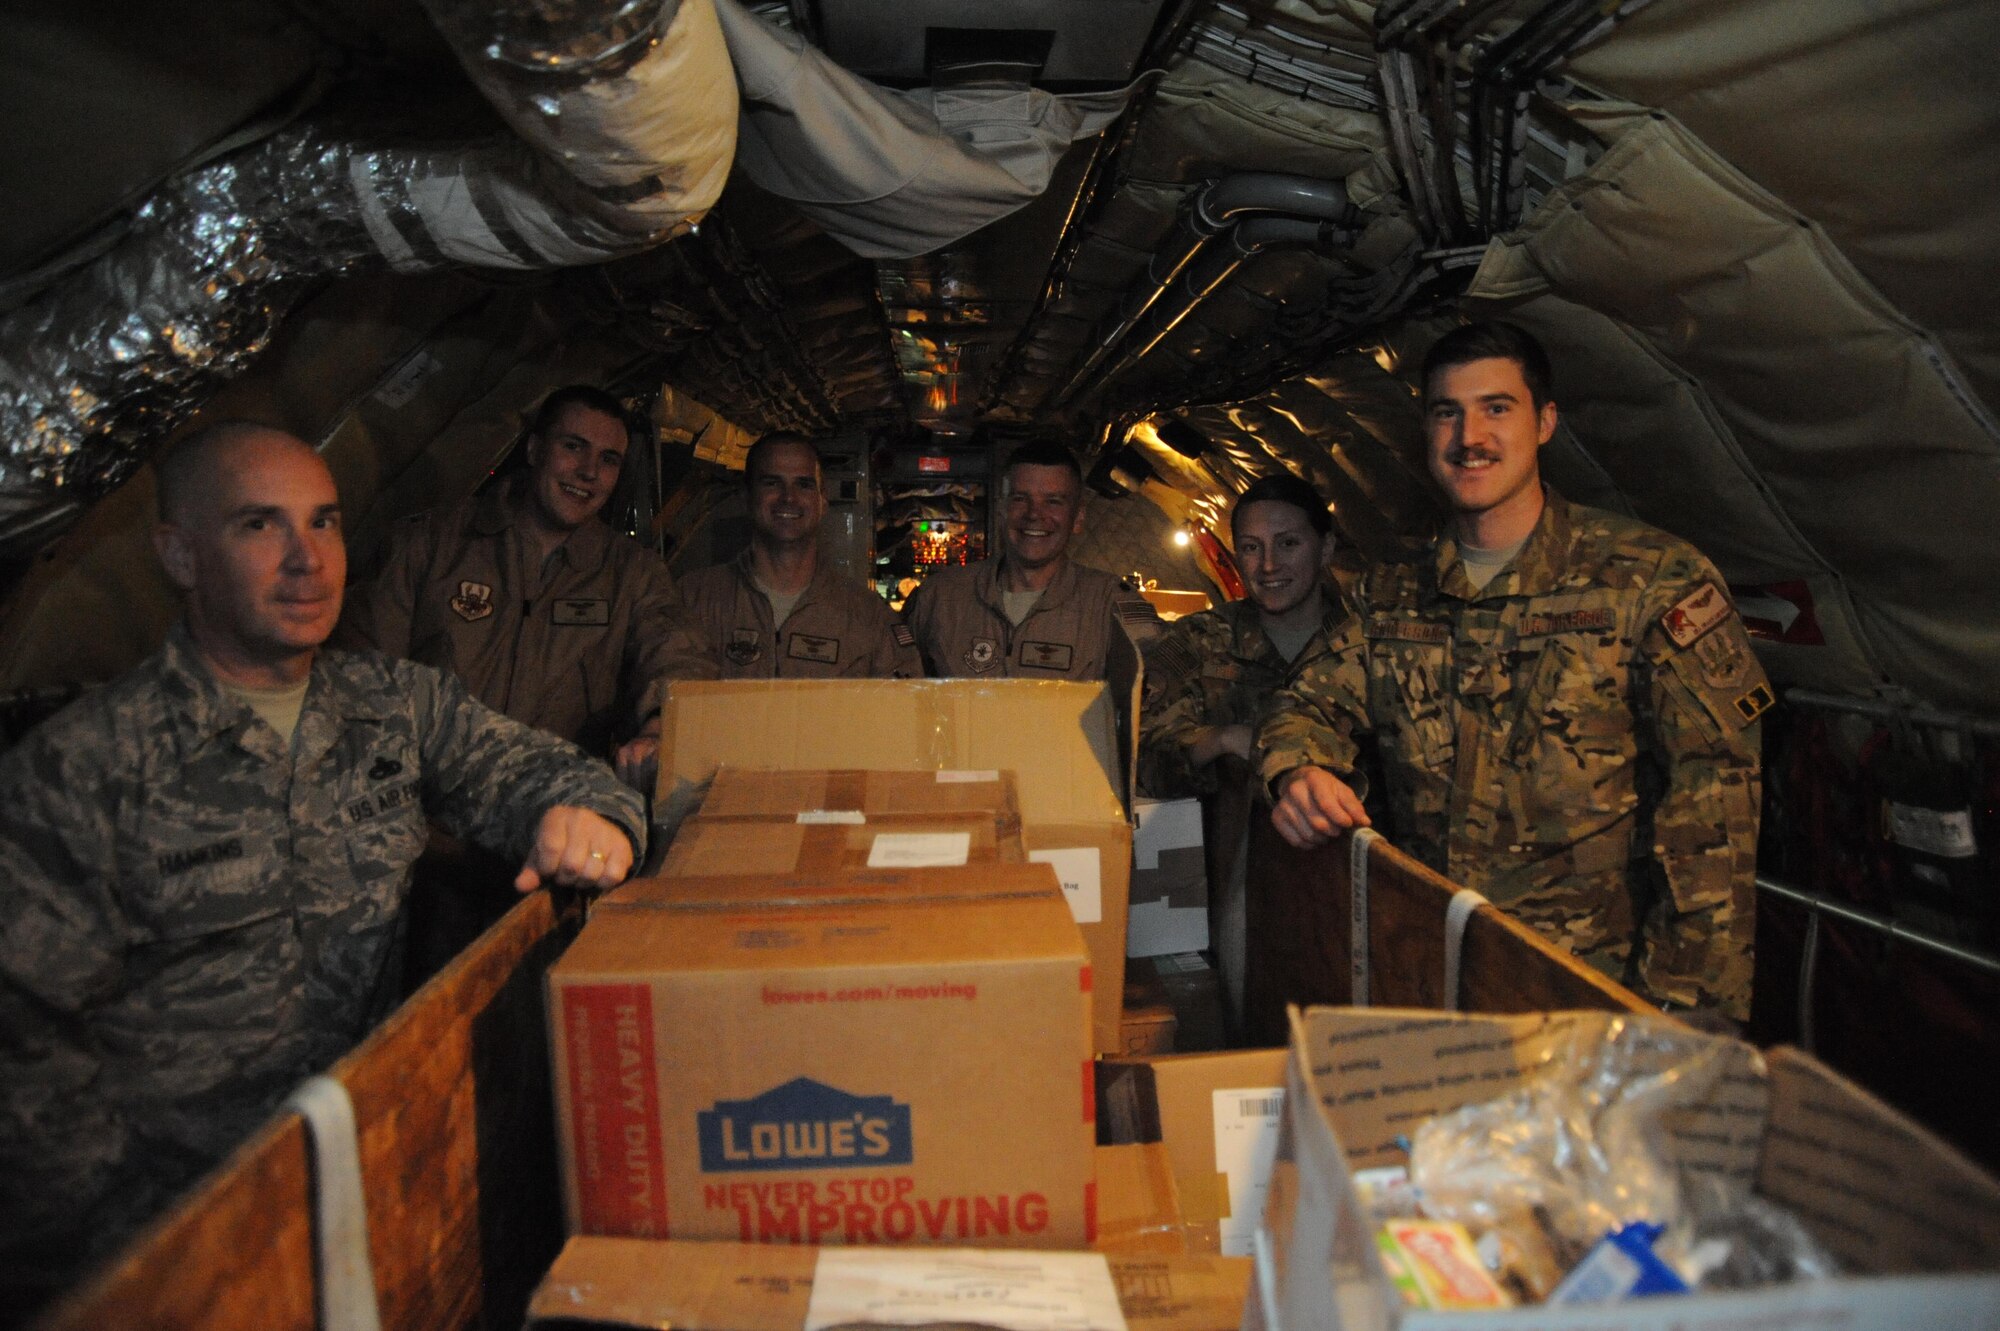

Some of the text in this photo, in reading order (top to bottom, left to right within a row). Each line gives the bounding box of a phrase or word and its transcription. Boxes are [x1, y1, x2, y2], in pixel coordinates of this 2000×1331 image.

[761, 981, 977, 1007] lowes.com/moving
[614, 1003, 645, 1115] HEAVY
[721, 1112, 891, 1162] LOWE'S
[623, 1122, 652, 1210] DUTY
[703, 1176, 915, 1209] NEVER STOP
[738, 1191, 1050, 1245] IMPROVING
